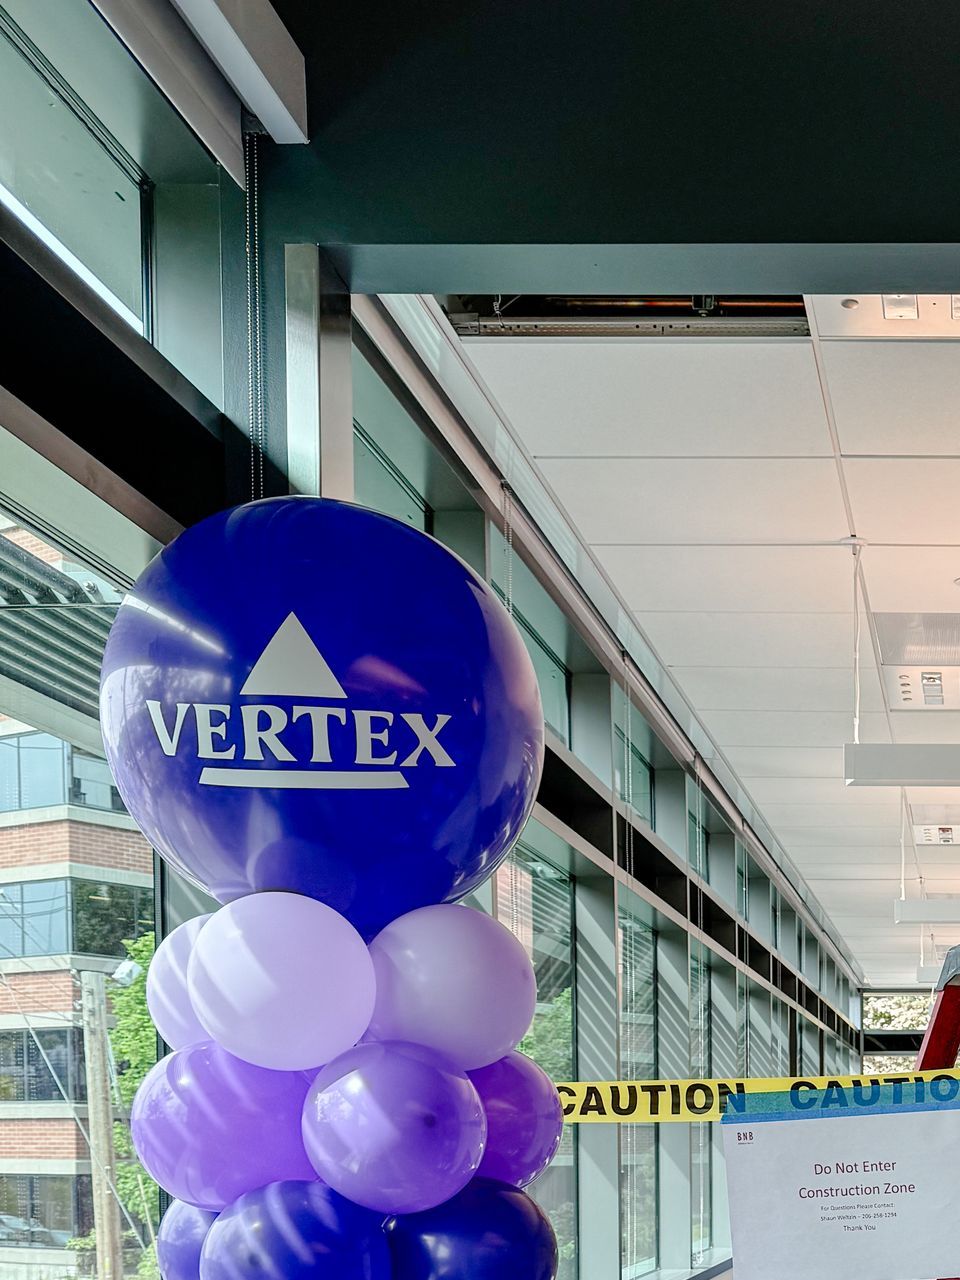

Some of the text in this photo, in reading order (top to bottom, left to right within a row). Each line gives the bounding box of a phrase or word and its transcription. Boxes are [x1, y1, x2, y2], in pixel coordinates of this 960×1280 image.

[145, 700, 456, 767] VERTEX
[556, 1083, 747, 1116] CAUTION
[737, 1131, 754, 1141] BNB
[814, 1160, 897, 1175] Do Not Enter
[799, 1182, 916, 1199] Construction Zone
